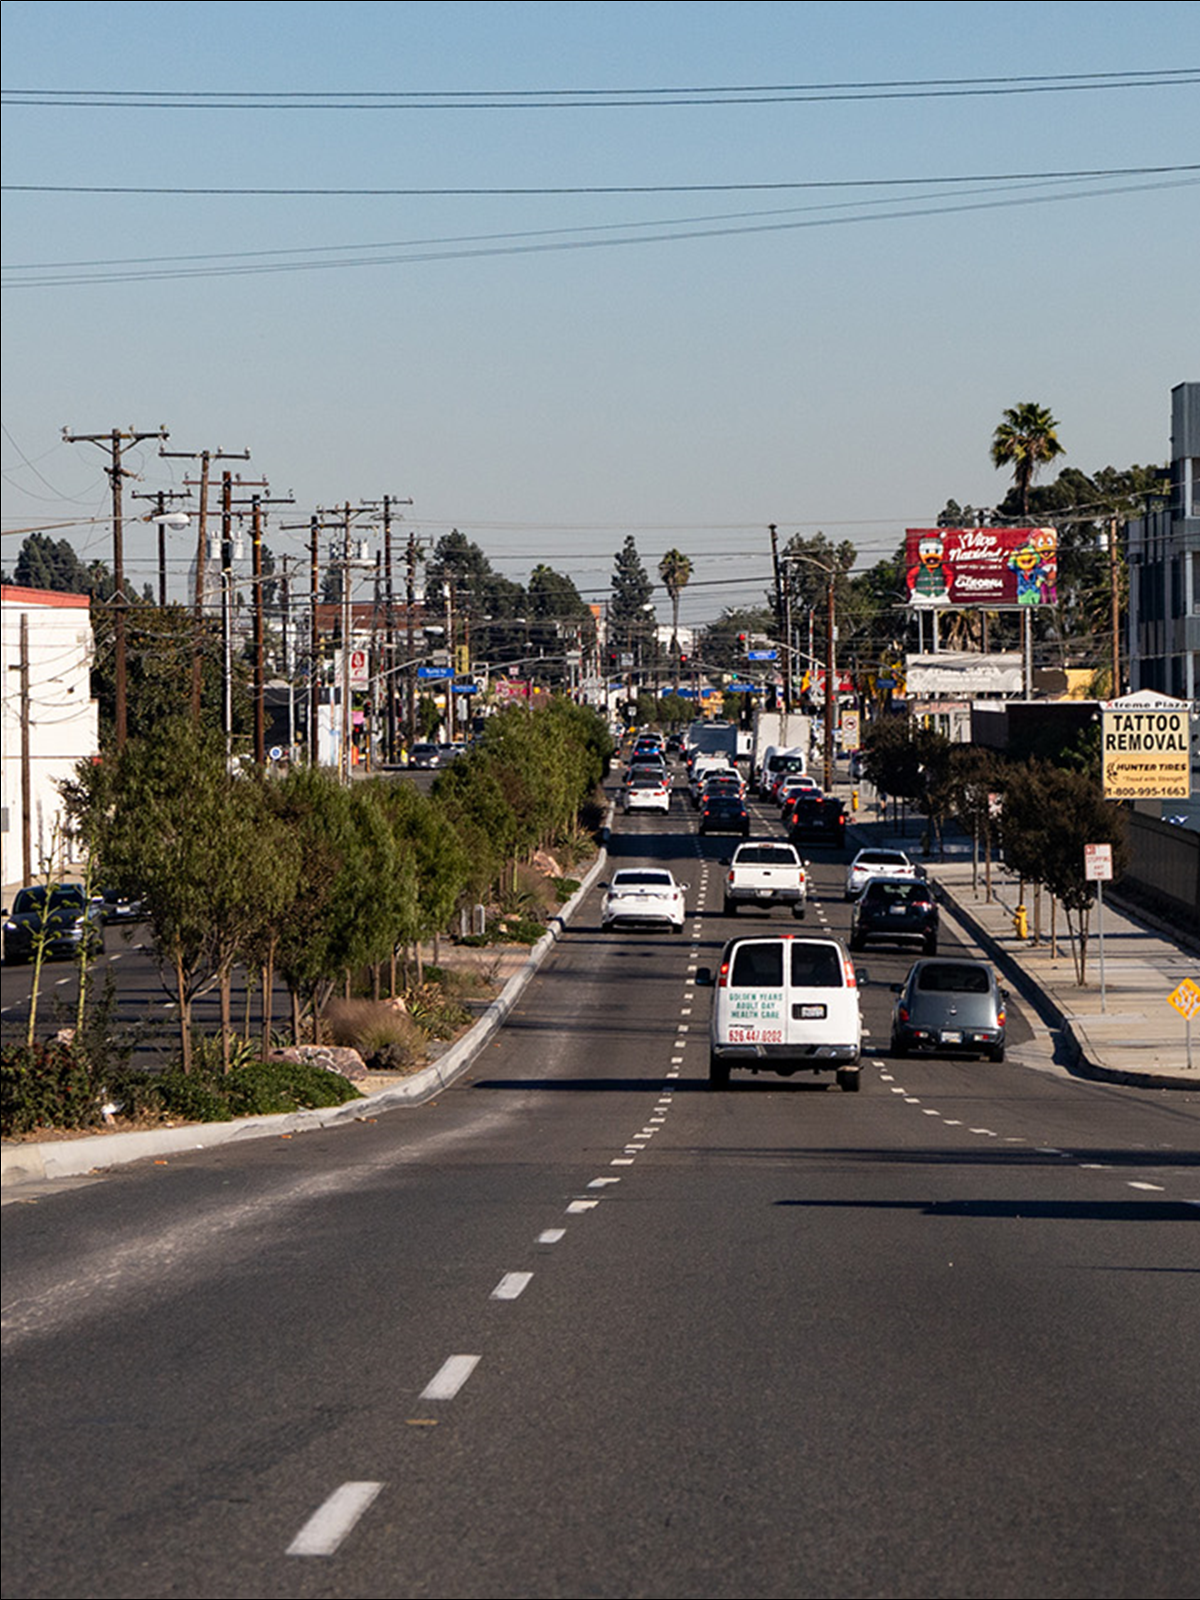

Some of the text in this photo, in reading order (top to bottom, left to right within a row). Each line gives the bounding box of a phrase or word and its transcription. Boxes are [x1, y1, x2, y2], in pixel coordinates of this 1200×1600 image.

[1155, 701, 1188, 709] Plaza
[1113, 714, 1181, 731] TATTOO
[1106, 734, 1187, 751] REMOVAL
[1116, 763, 1187, 771] HUNTER TIRES
[729, 993, 783, 1001] GOLDEN YEARS
